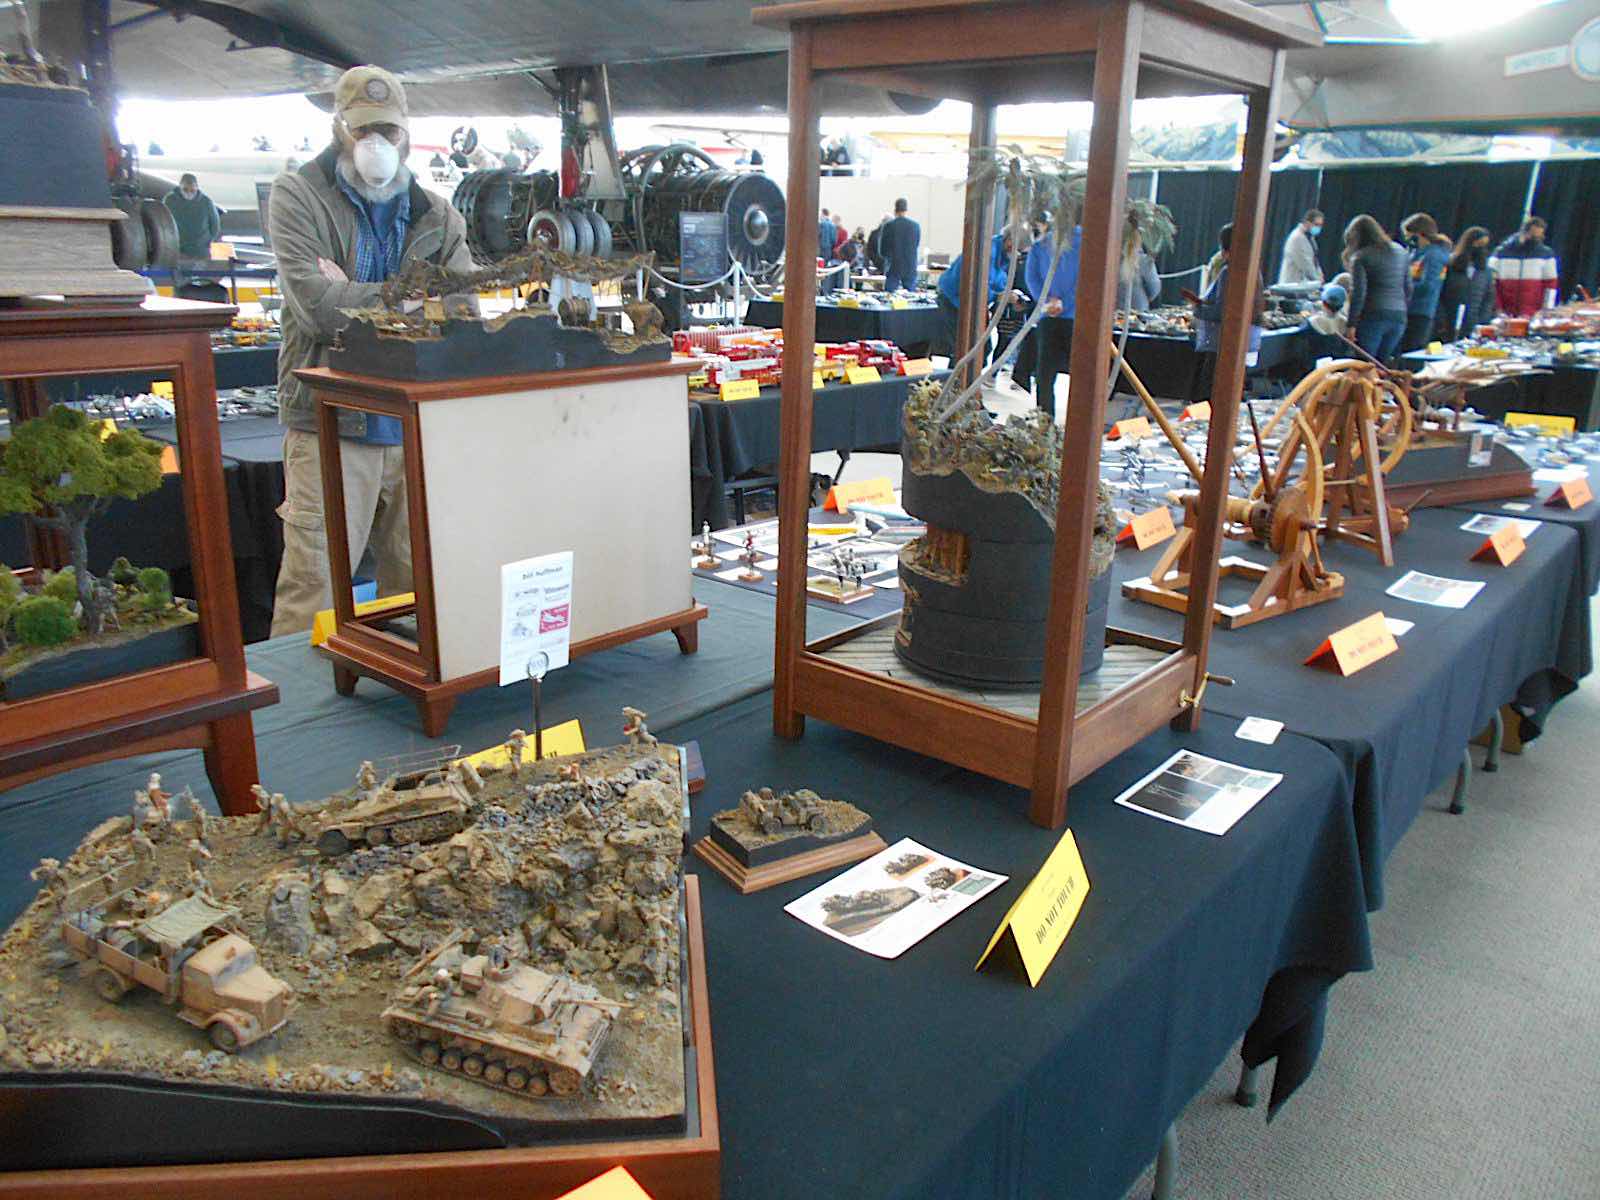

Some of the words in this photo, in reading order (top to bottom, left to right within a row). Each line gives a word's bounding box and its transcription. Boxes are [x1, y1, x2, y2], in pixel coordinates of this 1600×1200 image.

[1035, 924, 1047, 944] DO
[1045, 904, 1059, 927] NOT
[1057, 876, 1074, 909] TOUCH
